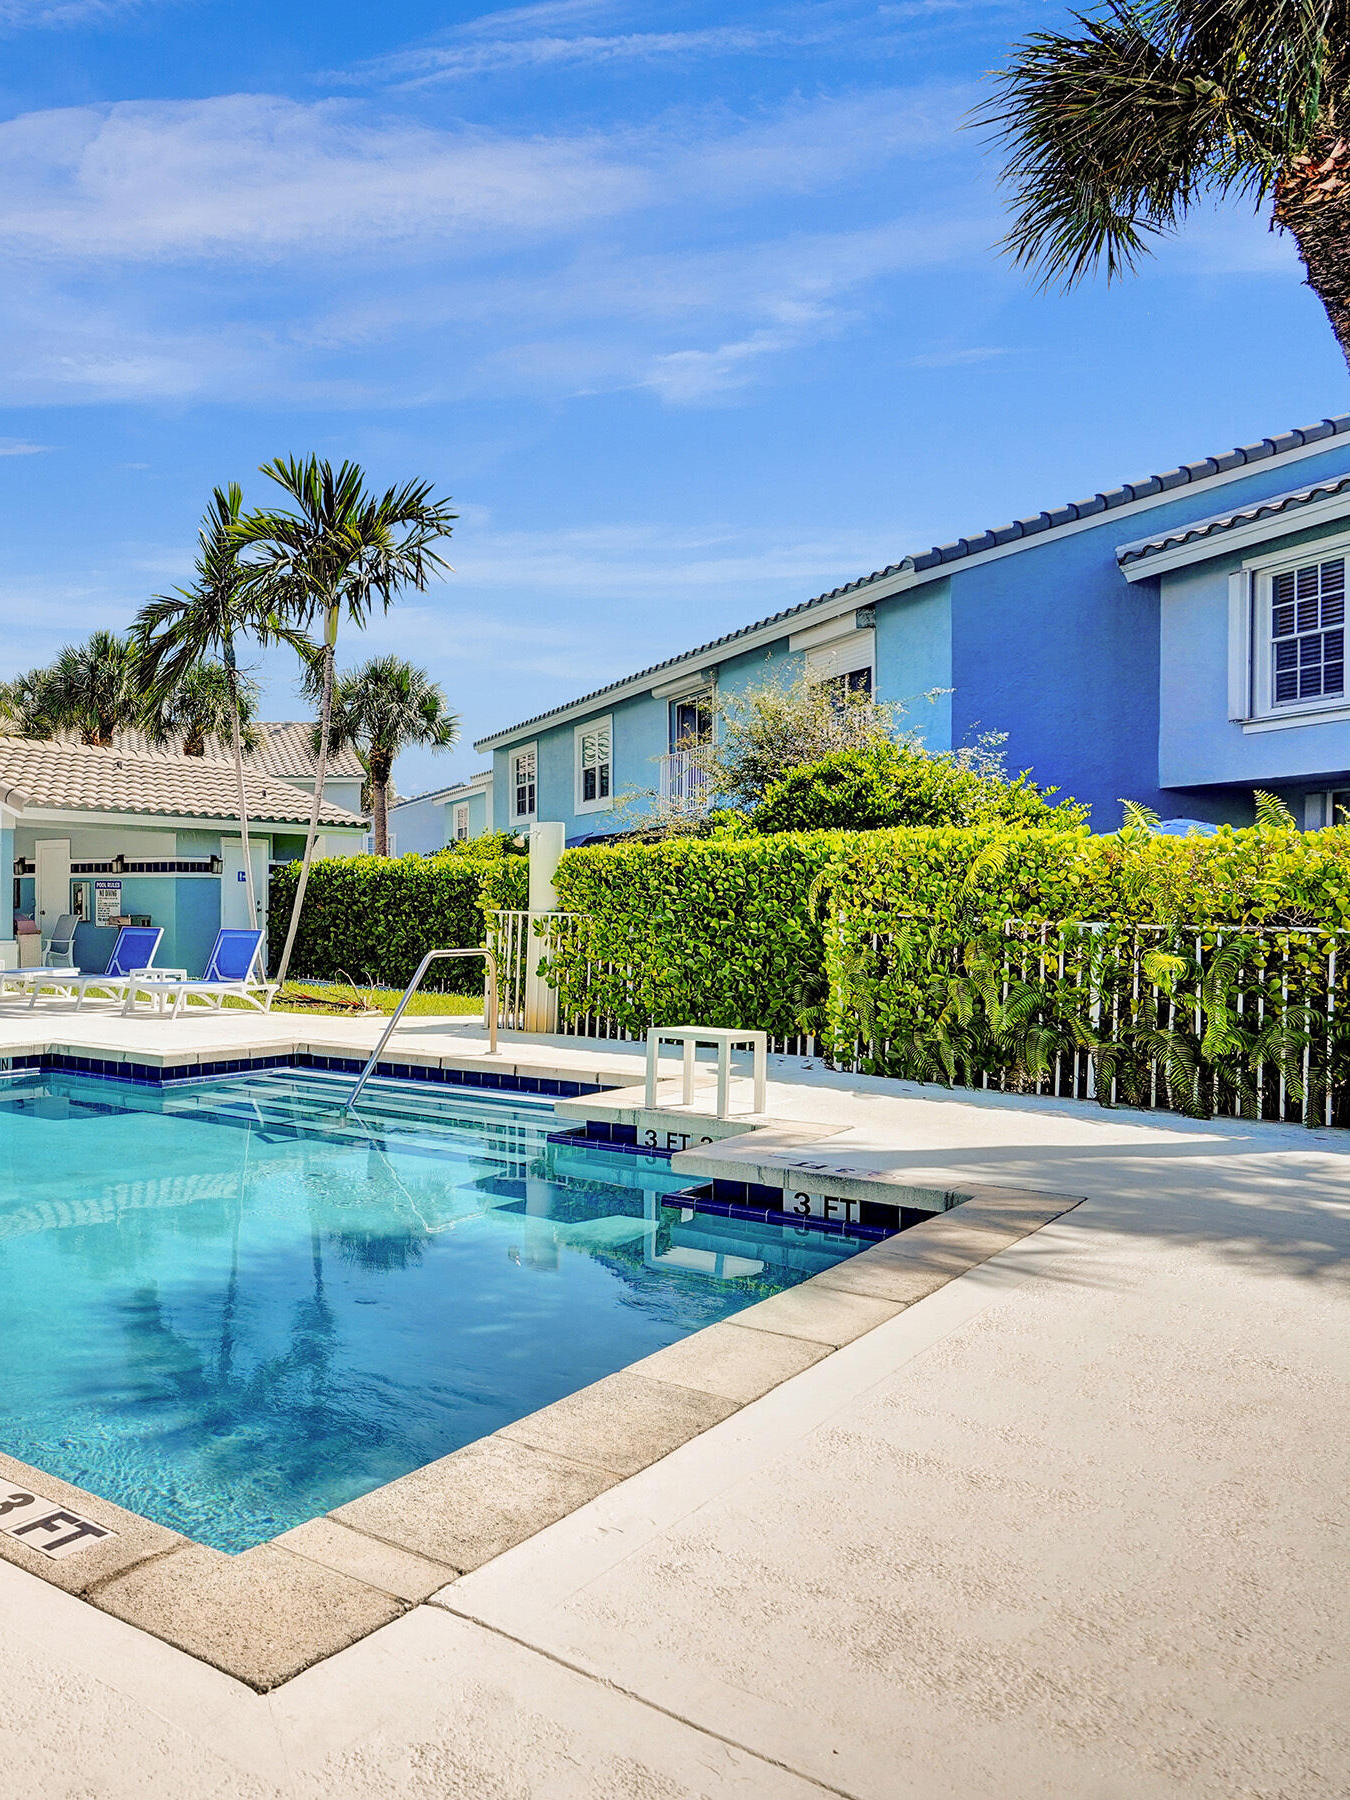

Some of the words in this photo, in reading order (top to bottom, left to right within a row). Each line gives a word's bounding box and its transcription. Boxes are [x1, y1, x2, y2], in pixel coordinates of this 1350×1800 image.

[644, 1129, 658, 1148] 3
[666, 1131, 691, 1151] FT
[793, 1191, 811, 1216] 3
[11, 1510, 109, 1552] FT
